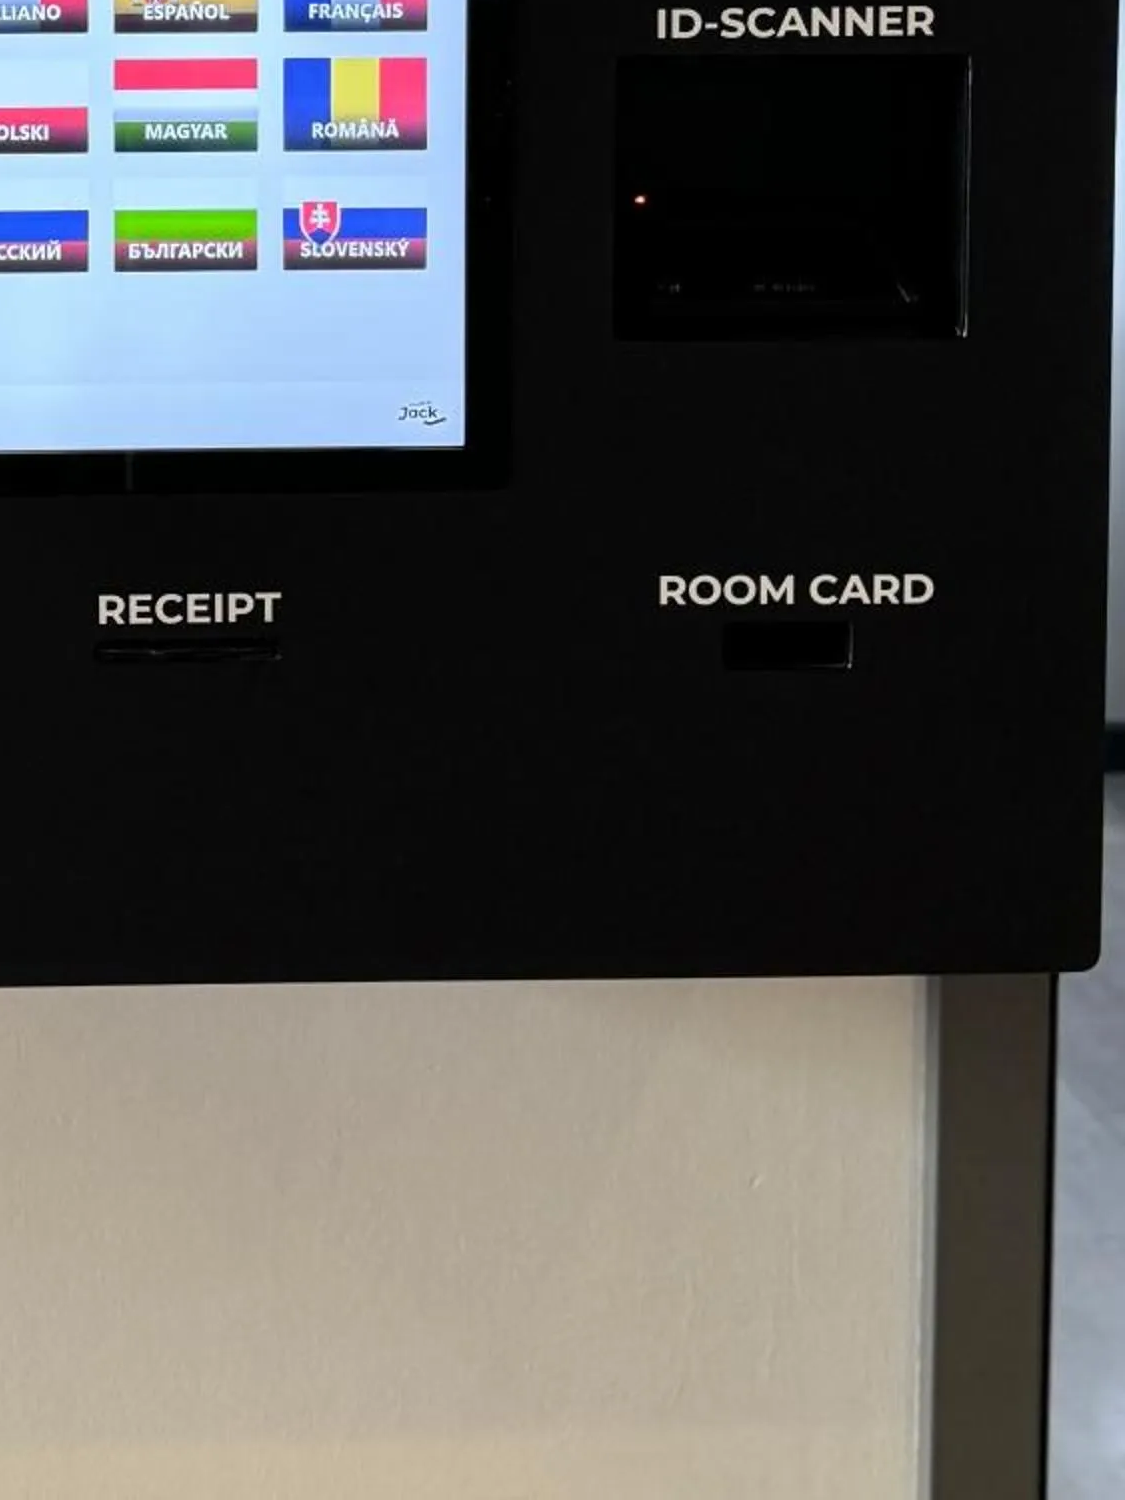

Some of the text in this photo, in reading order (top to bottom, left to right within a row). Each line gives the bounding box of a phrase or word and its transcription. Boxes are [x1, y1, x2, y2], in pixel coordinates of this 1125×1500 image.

[143, 0, 229, 21] ESPAÑOL
[308, 3, 404, 22] FRANÇAIS
[658, 6, 934, 39] ID-SCANNER
[144, 123, 227, 139] MAGYAR
[128, 242, 243, 260] БЪЛГАРСКИ
[301, 239, 409, 257] SLOVENSKÝ
[398, 406, 438, 420] Jack
[660, 574, 934, 605] ROOM CARD
[99, 592, 281, 624] RECEIPT
